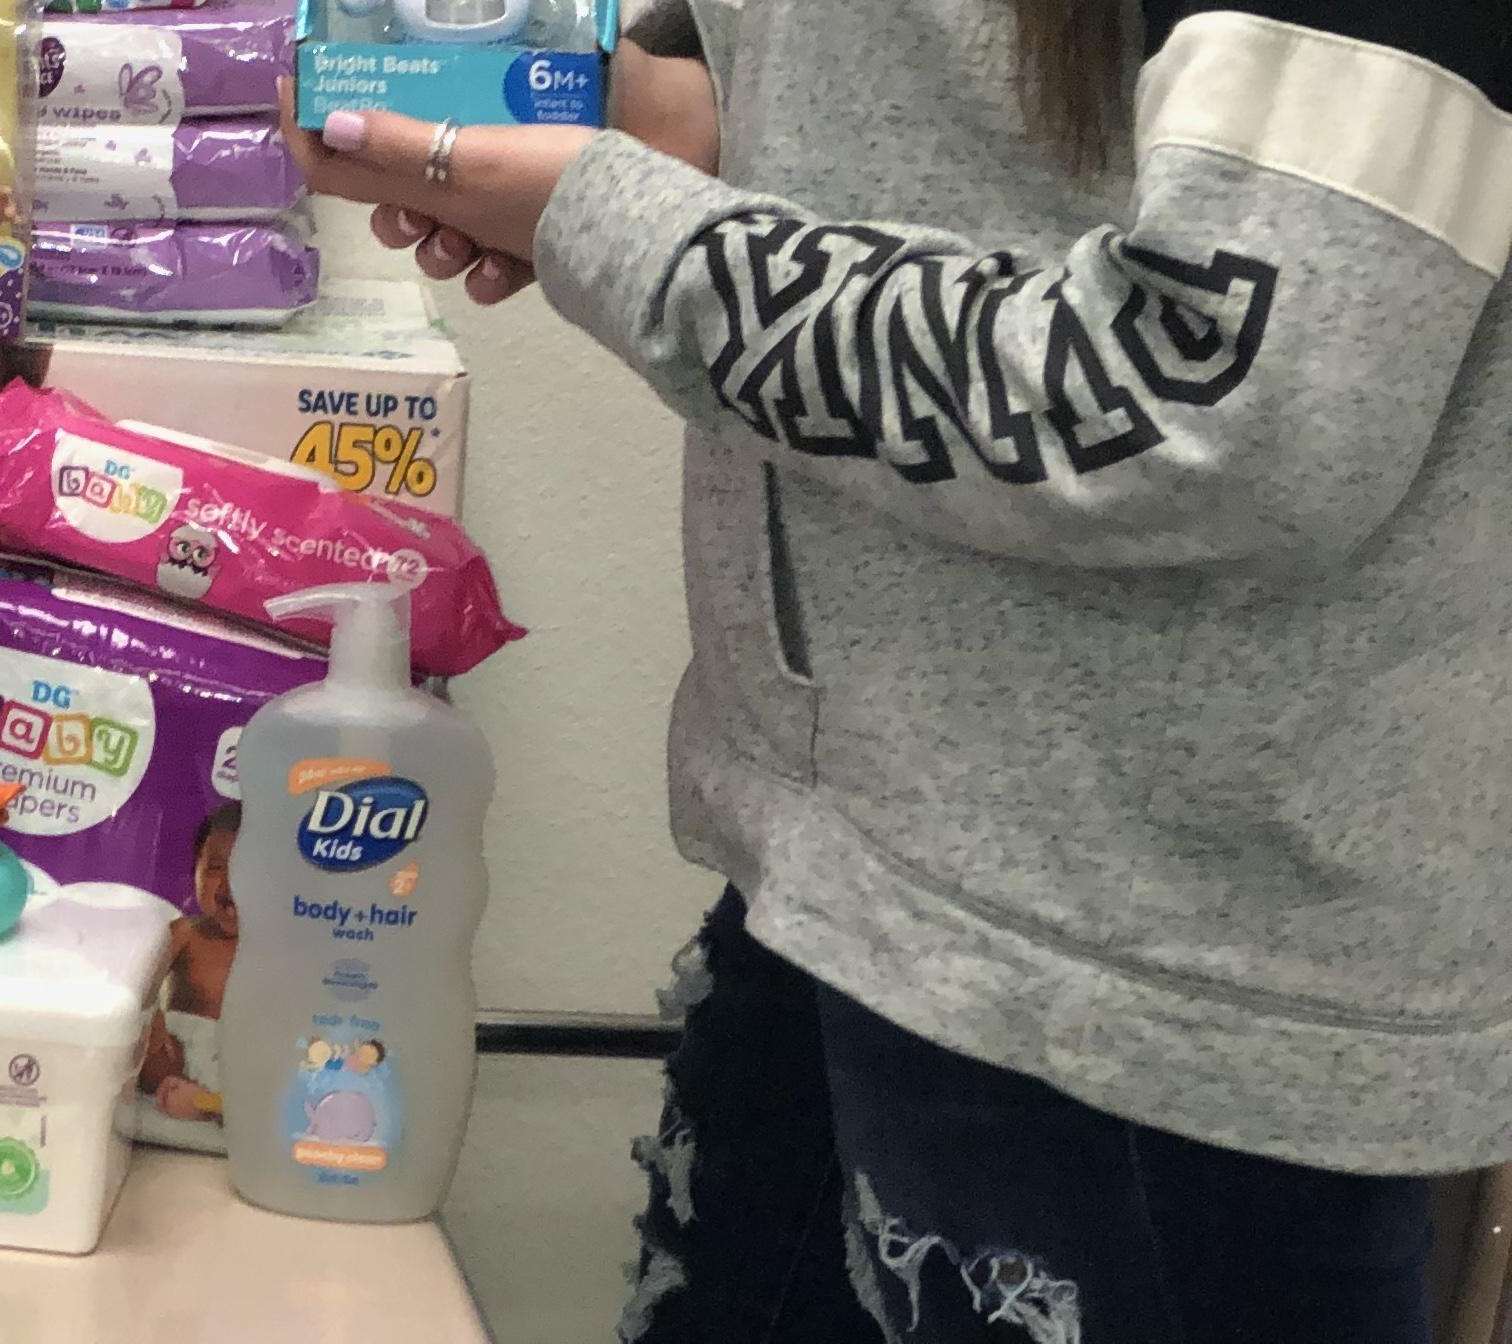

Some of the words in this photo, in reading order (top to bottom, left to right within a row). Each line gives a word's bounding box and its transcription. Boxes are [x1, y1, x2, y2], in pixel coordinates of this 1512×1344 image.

[313, 53, 376, 75] Bright
[313, 77, 388, 94] Juniors
[53, 105, 122, 123] wipes
[298, 389, 359, 415] SAVE
[366, 393, 399, 418] UP
[405, 396, 438, 420] TO
[105, 460, 131, 479] DG
[59, 465, 168, 524] baby
[186, 496, 269, 541] softly
[271, 527, 388, 575] scented
[32, 680, 71, 709] DG
[8, 792, 81, 824] apers
[308, 790, 426, 841] Dial
[313, 838, 364, 861] Kids
[293, 895, 351, 926] body
[369, 904, 419, 927] hair
[332, 927, 374, 942] wash
